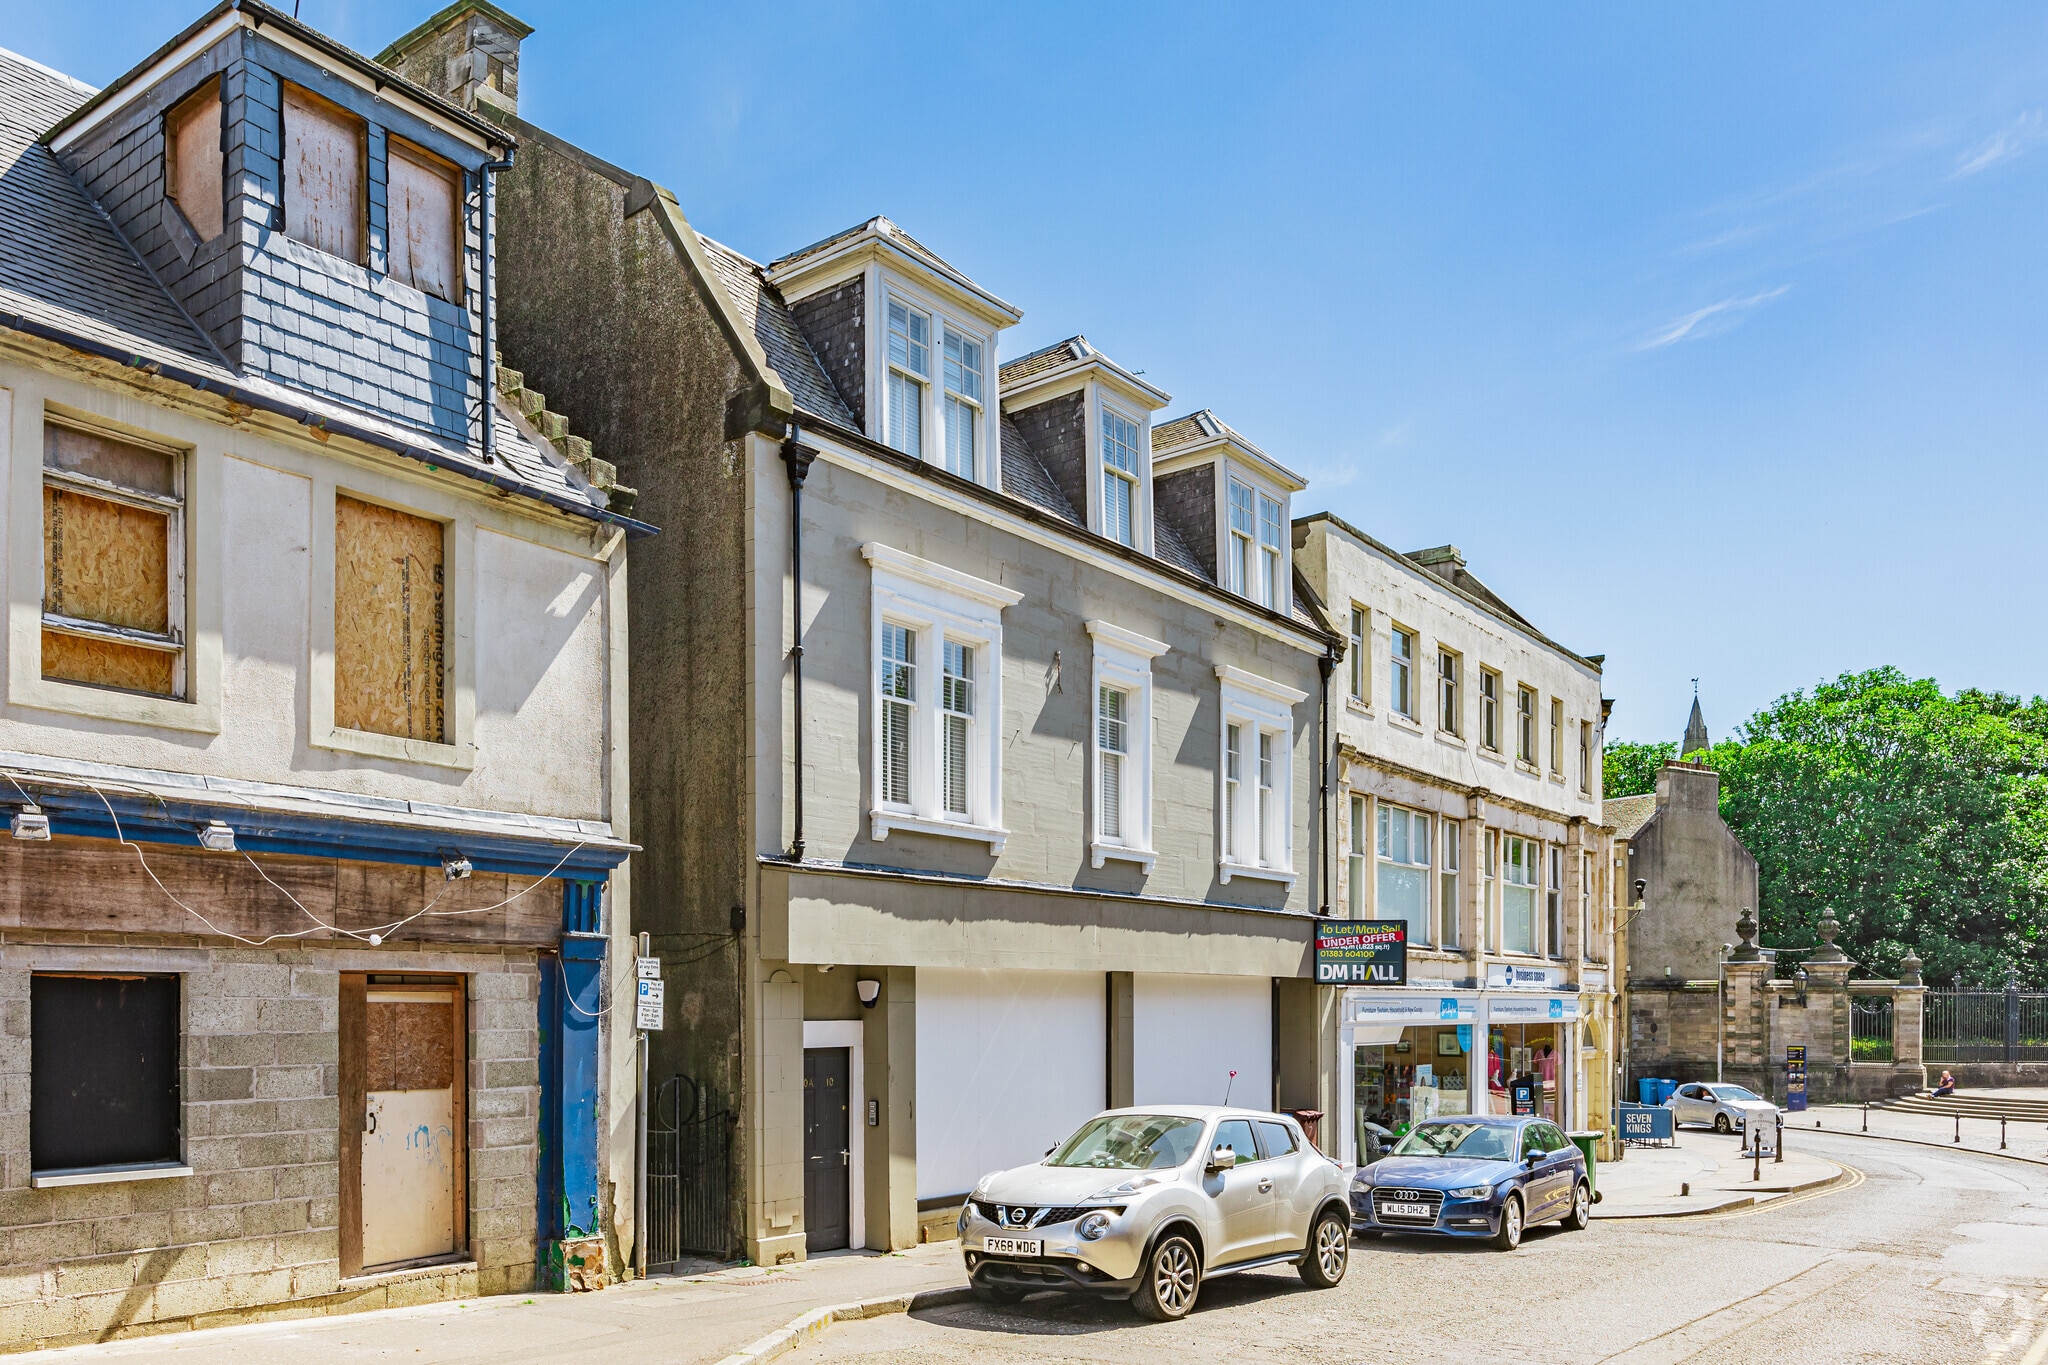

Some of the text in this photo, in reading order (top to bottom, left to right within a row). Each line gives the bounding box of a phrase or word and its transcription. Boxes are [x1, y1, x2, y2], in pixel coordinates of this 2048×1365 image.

[1321, 924, 1333, 934] To
[1381, 924, 1400, 933] Sell
[1322, 936, 1360, 948] UNDER
[1362, 932, 1396, 944] OFFER
[1320, 950, 1375, 958] 01383 604100
[1319, 964, 1400, 980] DM HALL
[826, 1078, 834, 1086] 10
[1520, 1090, 1527, 1098] P
[1626, 1114, 1652, 1123] SEVEN
[1626, 1124, 1652, 1133] KINGS
[1386, 1204, 1424, 1214] WL15 DHZ
[988, 1238, 1036, 1253] FX68 WDG
